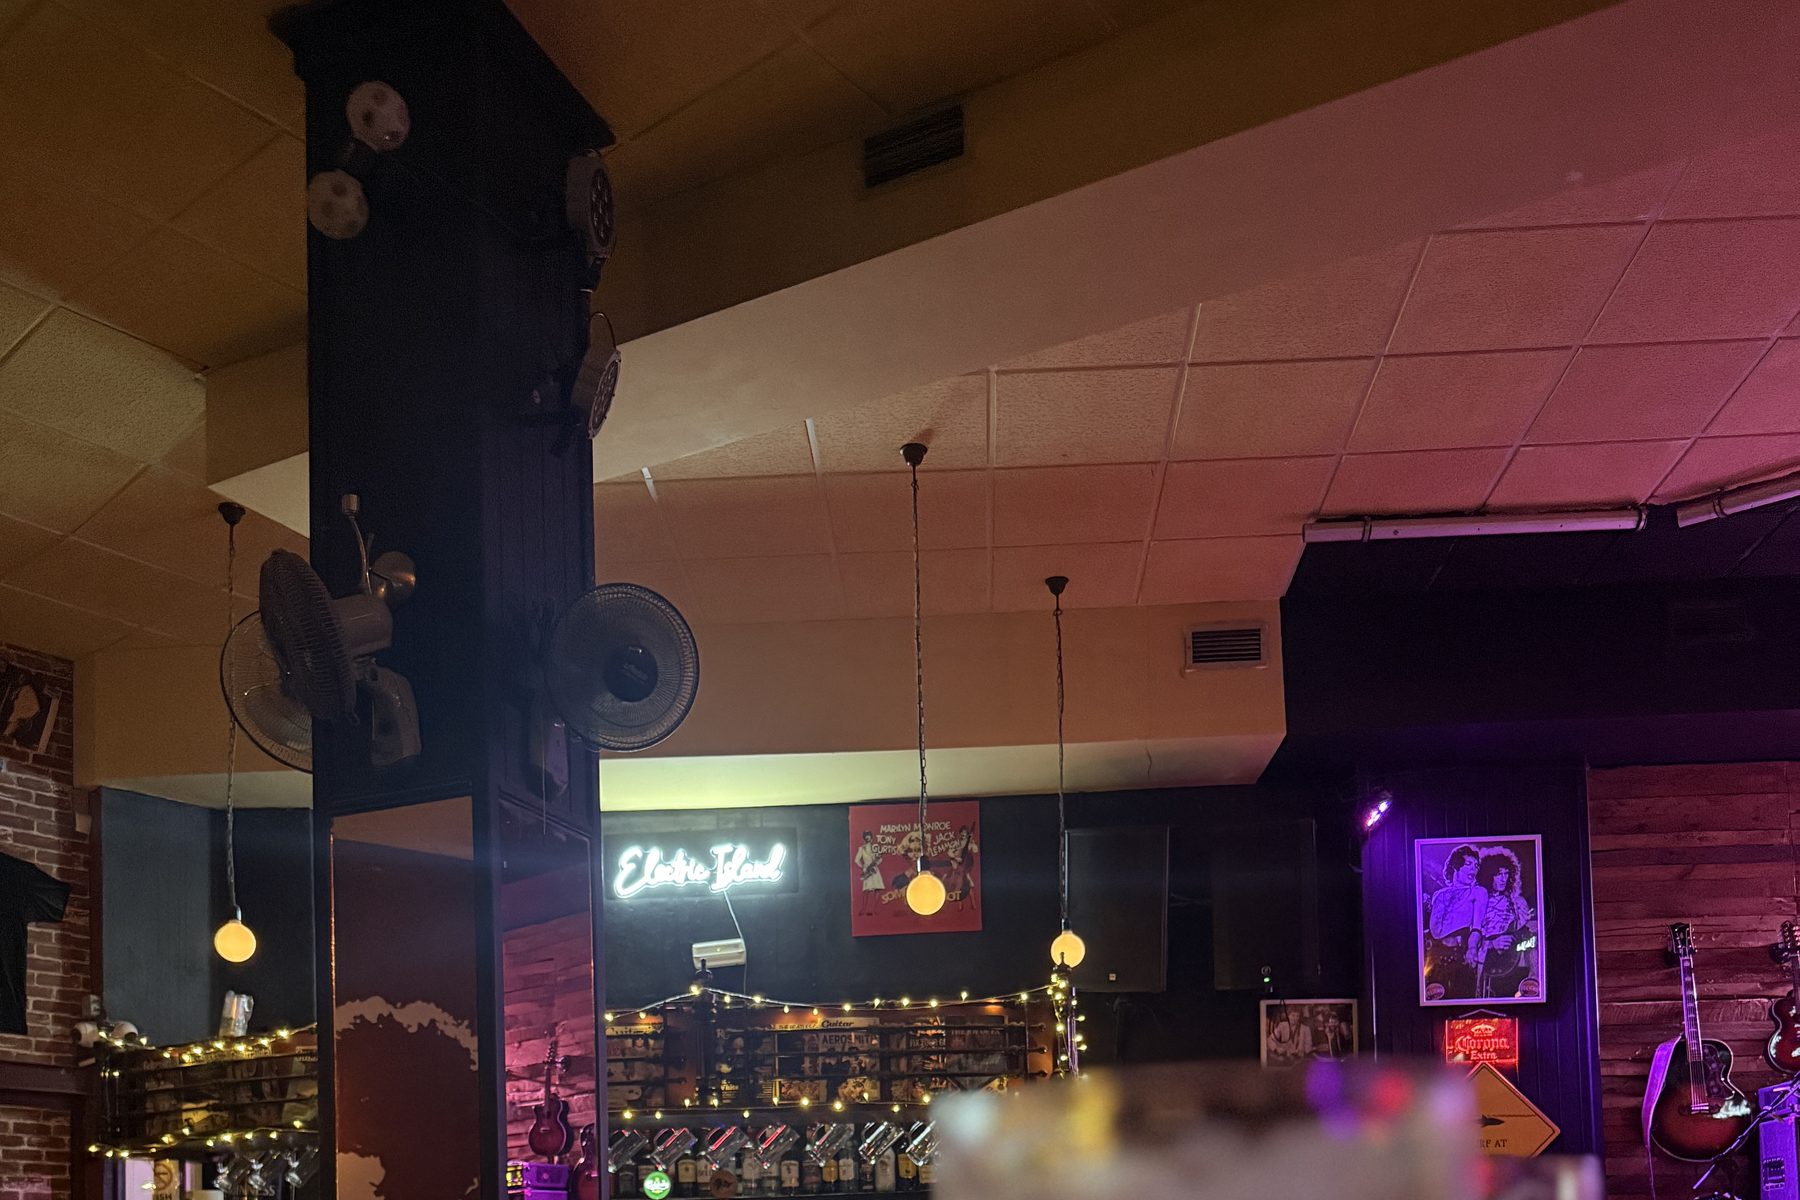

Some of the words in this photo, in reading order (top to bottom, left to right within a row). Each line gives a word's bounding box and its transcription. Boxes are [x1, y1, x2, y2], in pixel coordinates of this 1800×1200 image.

[880, 823, 911, 833] MARILYN
[876, 834, 896, 844] TONY
[933, 831, 955, 845] JACK
[872, 843, 898, 855] CURTIS
[881, 889, 907, 904] SOM
[821, 1020, 854, 1028] Guitar
[1454, 1036, 1509, 1054] Corona
[1470, 1050, 1498, 1060] Extra
